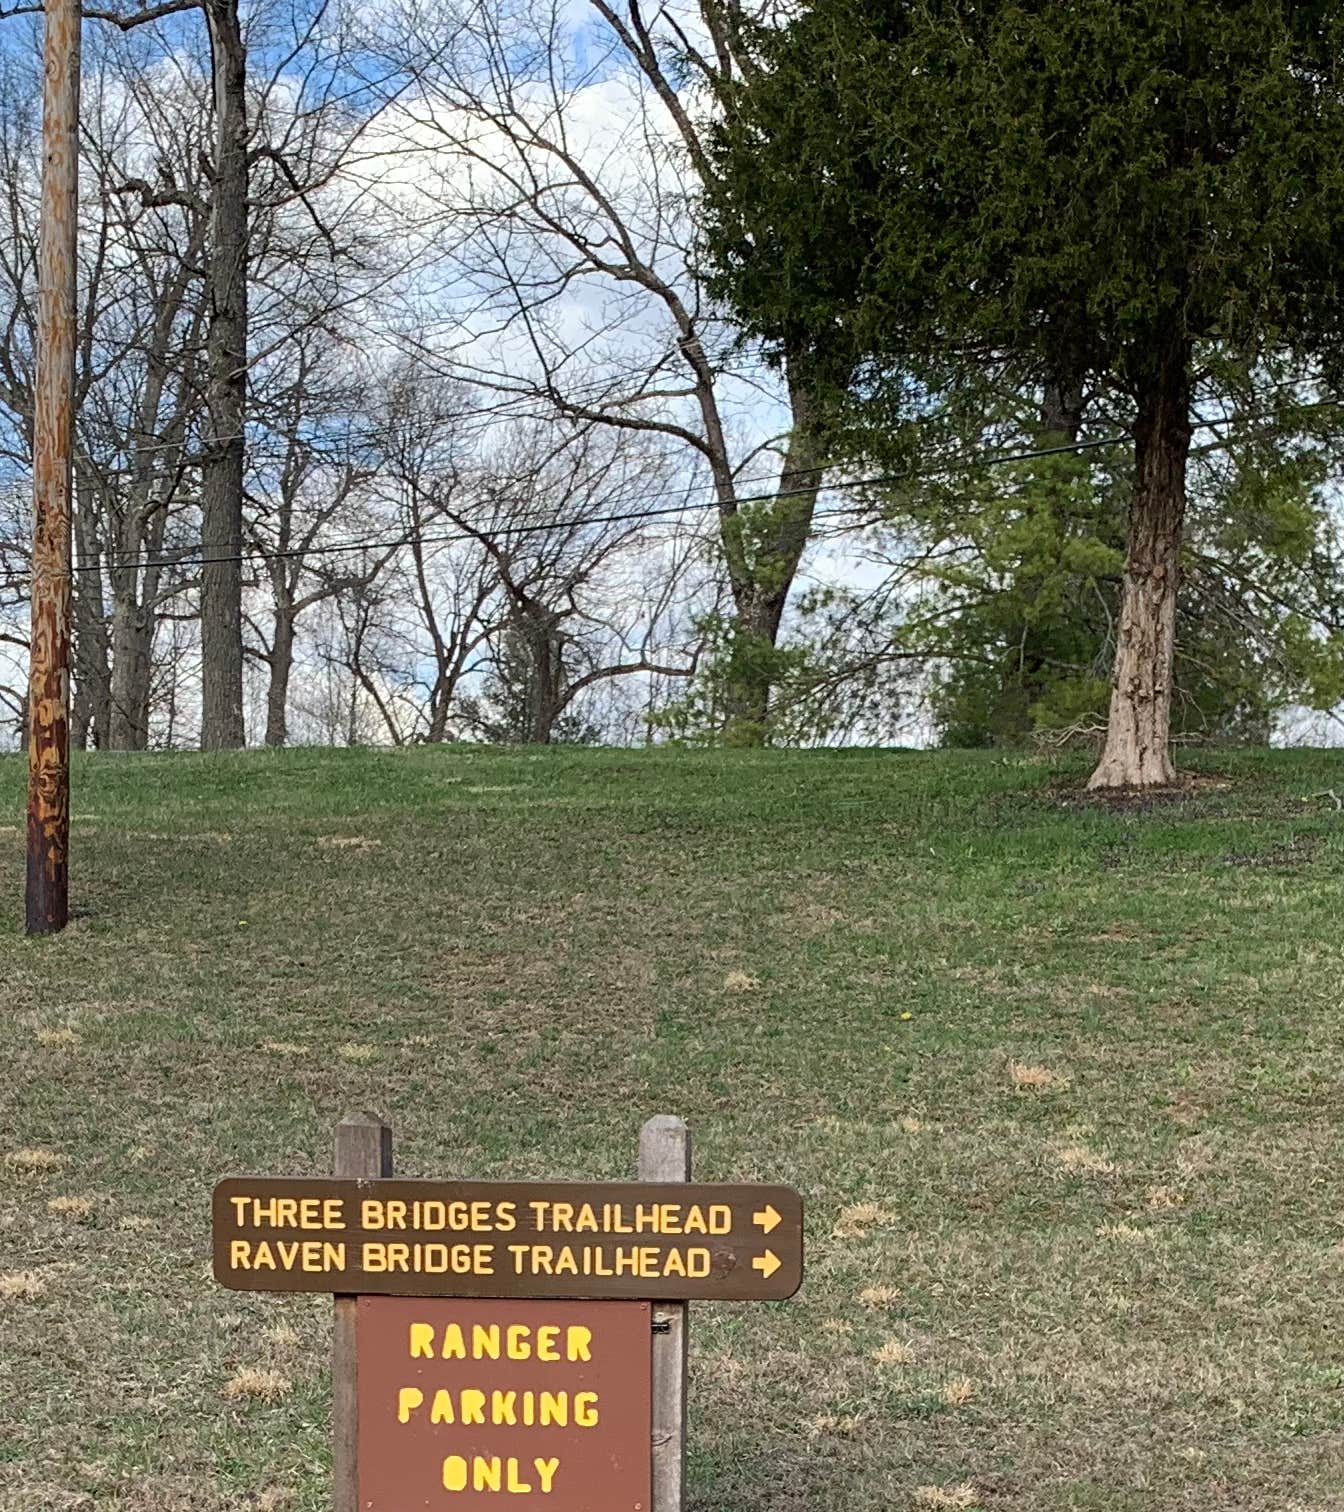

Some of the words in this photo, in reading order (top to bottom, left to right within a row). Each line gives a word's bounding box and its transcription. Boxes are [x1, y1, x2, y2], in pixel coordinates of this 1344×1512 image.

[230, 1196, 346, 1230] THREE
[361, 1200, 516, 1232] BRIDGES
[528, 1201, 732, 1235] TRAILHEAD
[230, 1240, 346, 1272] RAVEN
[362, 1242, 495, 1275] BRIDGE
[507, 1245, 711, 1278] TRAILHEAD
[409, 1322, 593, 1362] RANGER
[397, 1387, 599, 1428] PARKING
[442, 1455, 561, 1494] ONLY
